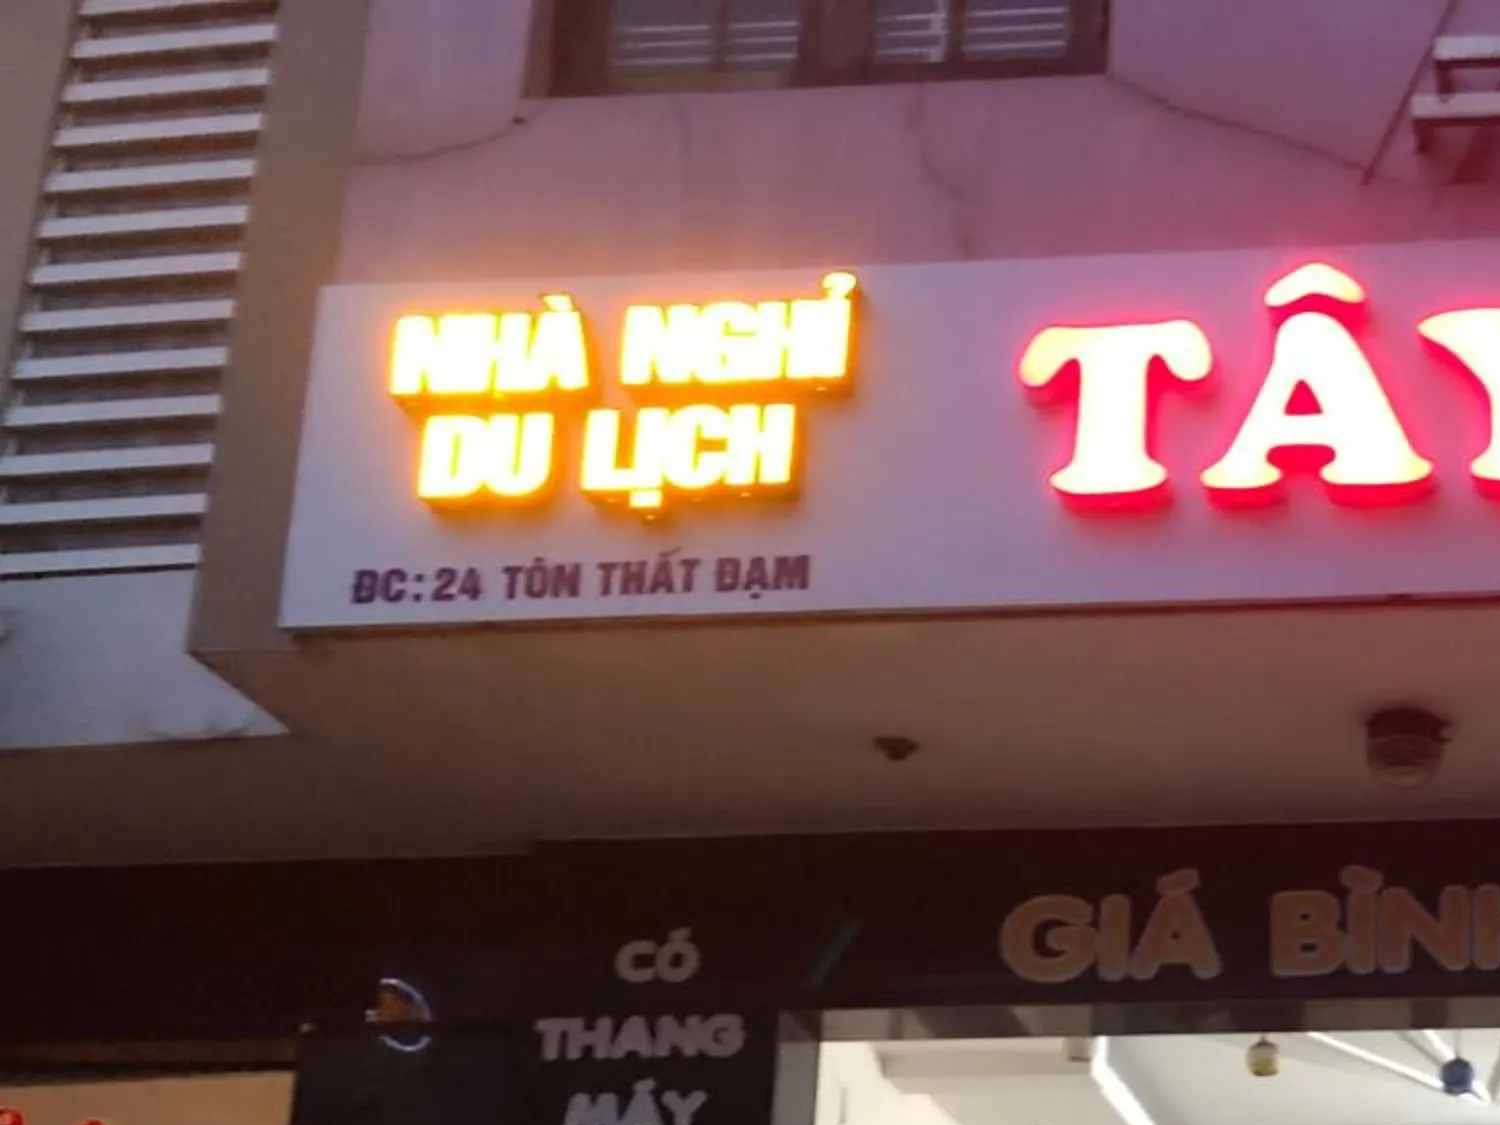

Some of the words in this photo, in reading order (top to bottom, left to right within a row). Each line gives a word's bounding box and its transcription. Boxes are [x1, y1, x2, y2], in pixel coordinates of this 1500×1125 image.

[390, 292, 589, 396] NHÀ
[620, 271, 857, 385] NGHỈ
[417, 412, 554, 498] DU
[580, 404, 795, 507] LỊCH
[502, 560, 582, 599] TÔN
[597, 547, 701, 597] THẤT
[715, 554, 809, 600] ĐẠM
[615, 927, 701, 983] CÓ
[1000, 870, 1221, 983] GIÁ
[533, 1013, 747, 1060] THANG
